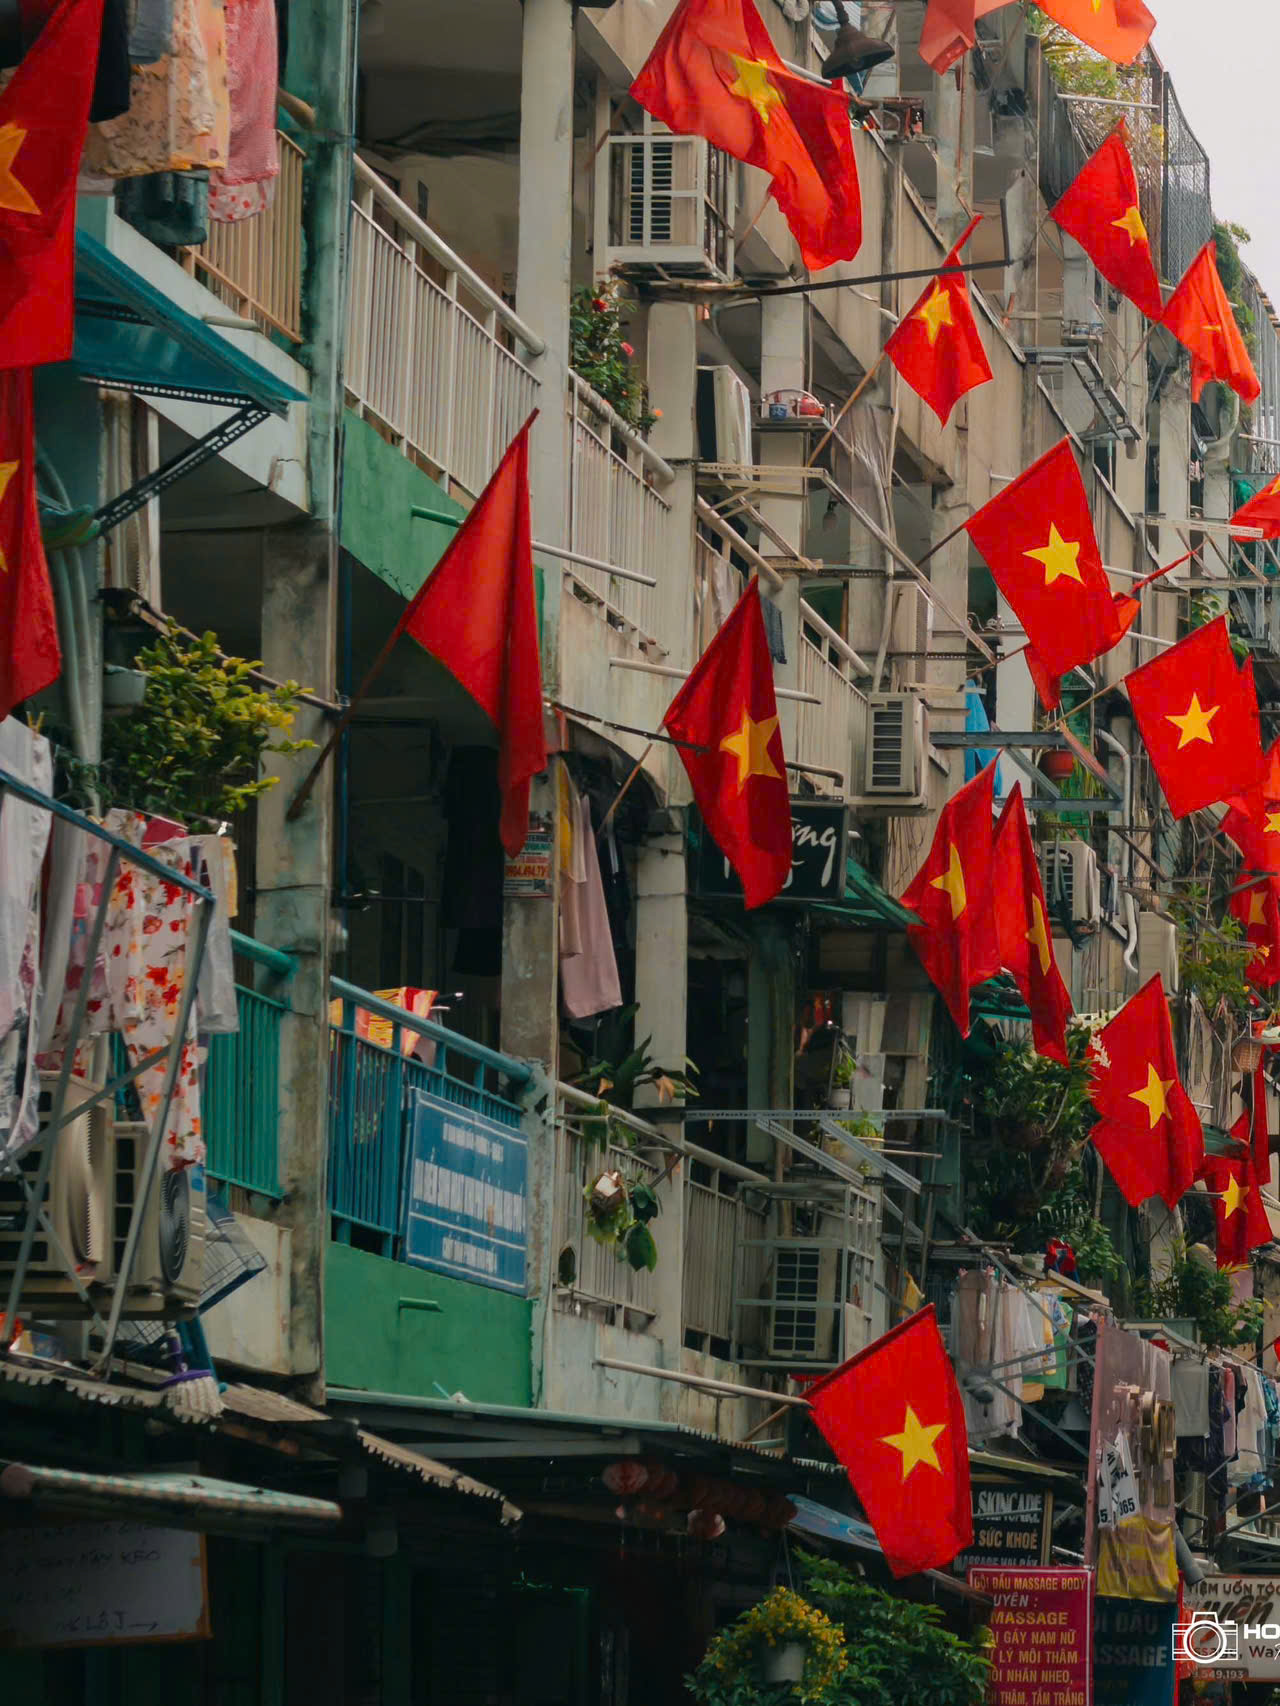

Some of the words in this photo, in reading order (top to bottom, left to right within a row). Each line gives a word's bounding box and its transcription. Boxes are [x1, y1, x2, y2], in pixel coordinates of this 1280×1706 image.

[978, 1527, 1003, 1547] SỨC
[1014, 1577, 1058, 1591] MASSAGE
[1061, 1577, 1087, 1591] BODY
[993, 1592, 1030, 1608] UYÊN
[991, 1611, 1069, 1625] MASSAGE
[1031, 1631, 1057, 1646] NAM
[1019, 1647, 1041, 1664] MÔI
